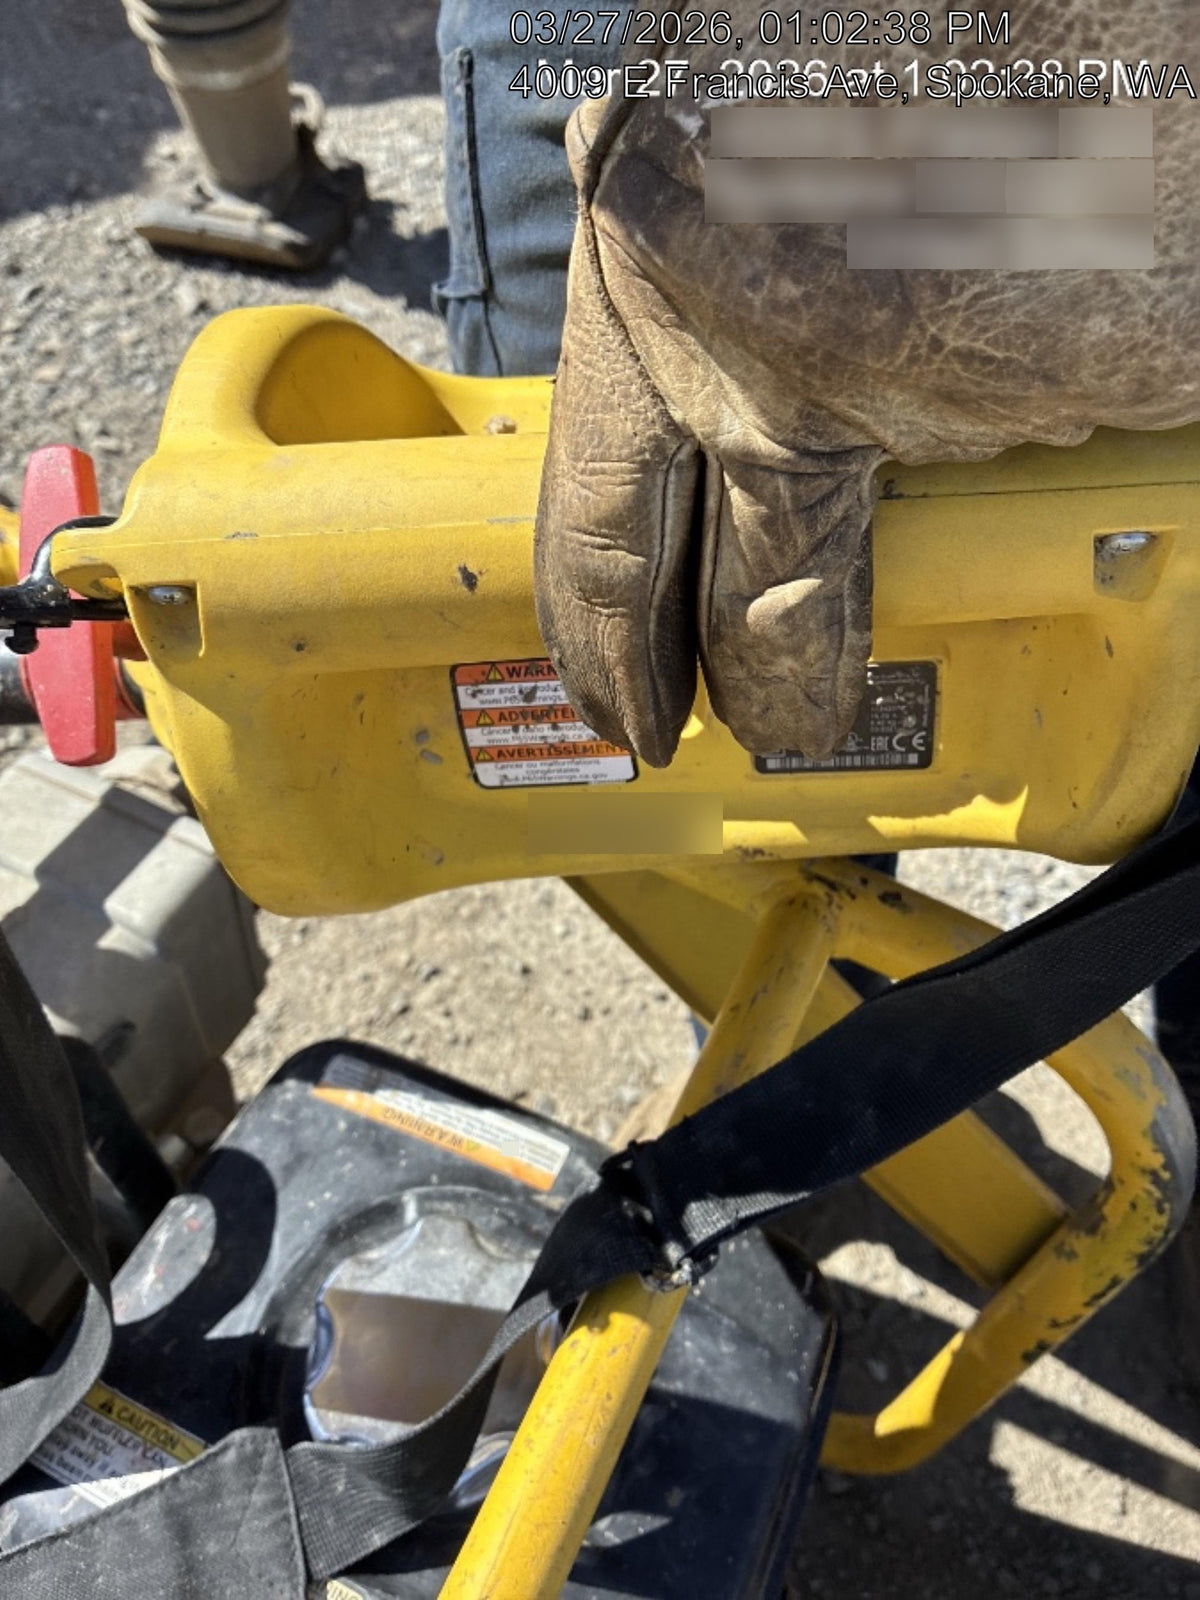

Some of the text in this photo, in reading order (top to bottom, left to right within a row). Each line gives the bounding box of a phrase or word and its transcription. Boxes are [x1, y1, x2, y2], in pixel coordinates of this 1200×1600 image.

[506, 662, 558, 679] WARN
[500, 707, 576, 722] ADVERTE
[117, 1406, 180, 1449] CAUTION
